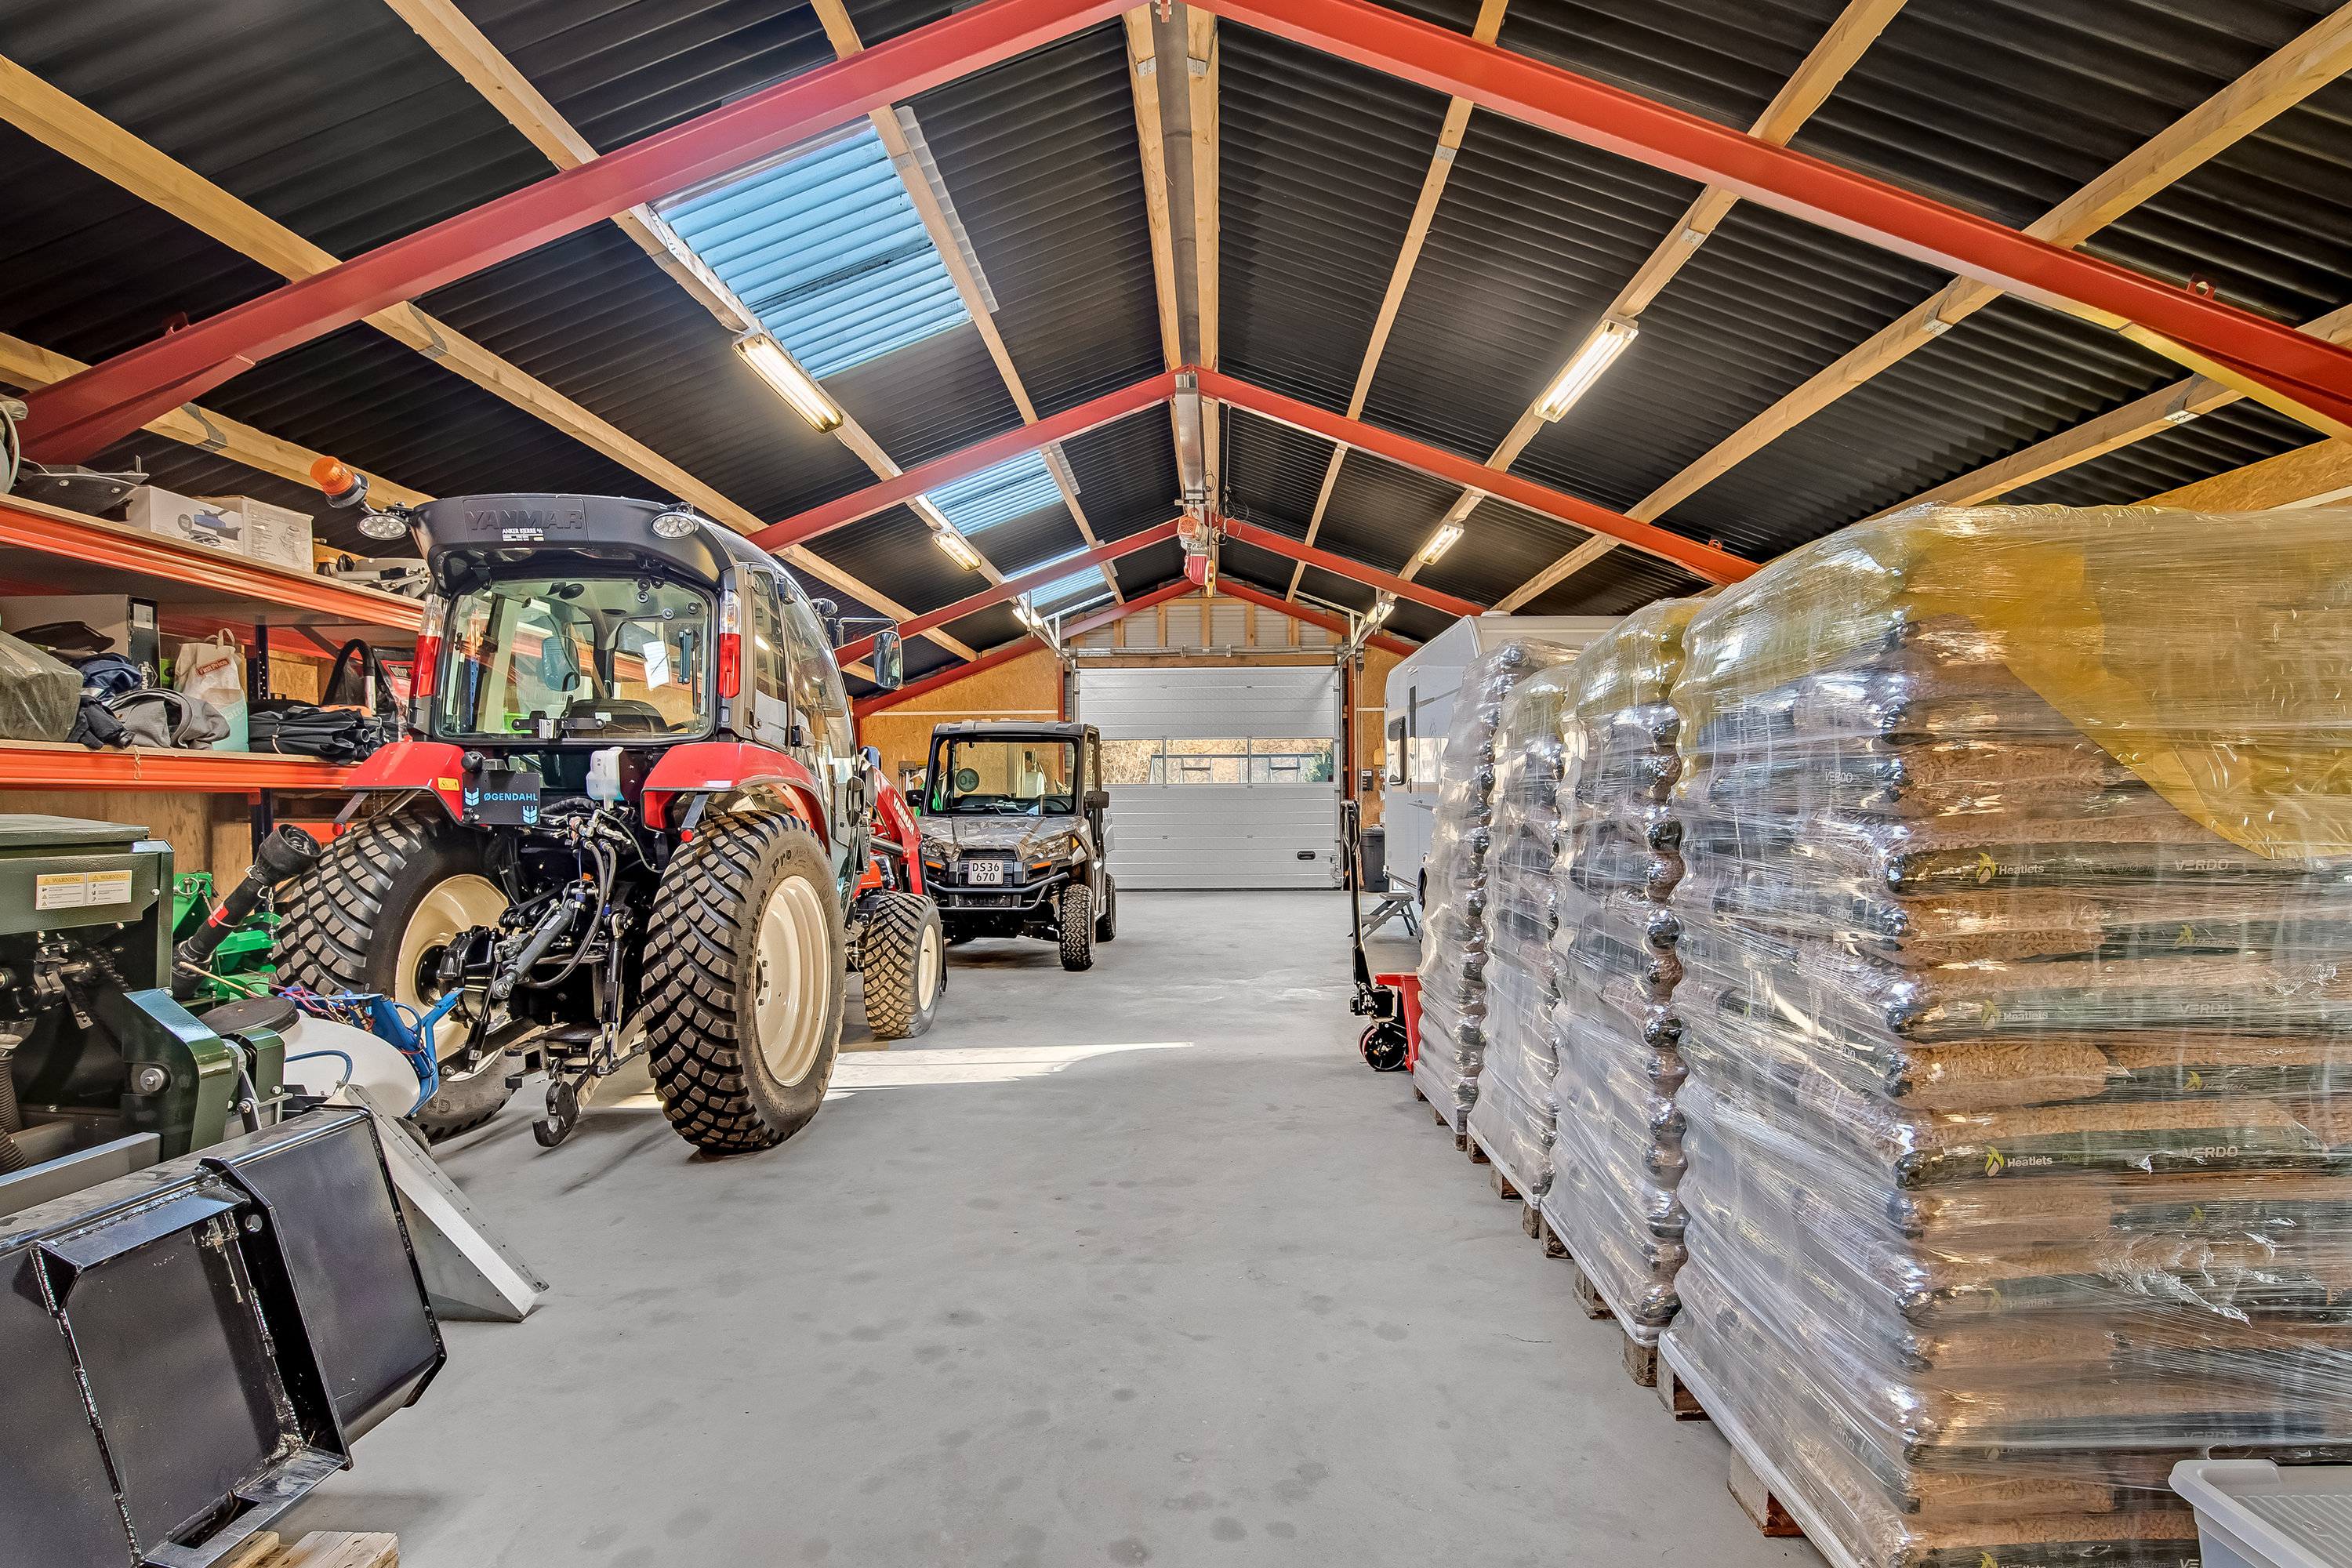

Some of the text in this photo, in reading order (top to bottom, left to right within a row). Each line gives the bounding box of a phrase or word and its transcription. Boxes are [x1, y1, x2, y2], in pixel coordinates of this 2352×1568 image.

[466, 510, 583, 530] YANMAR
[1998, 712, 2034, 723] eatlets
[483, 792, 539, 802] ØGENDAHL
[893, 793, 916, 837] YANMAR
[1998, 864, 2045, 876] Heatlets
[2175, 858, 2230, 871] VERDO
[975, 872, 996, 882] 670
[2003, 1011, 2049, 1022] Heatlets
[2007, 1156, 2053, 1168] Heatlets
[2183, 1145, 2238, 1159] VERDO
